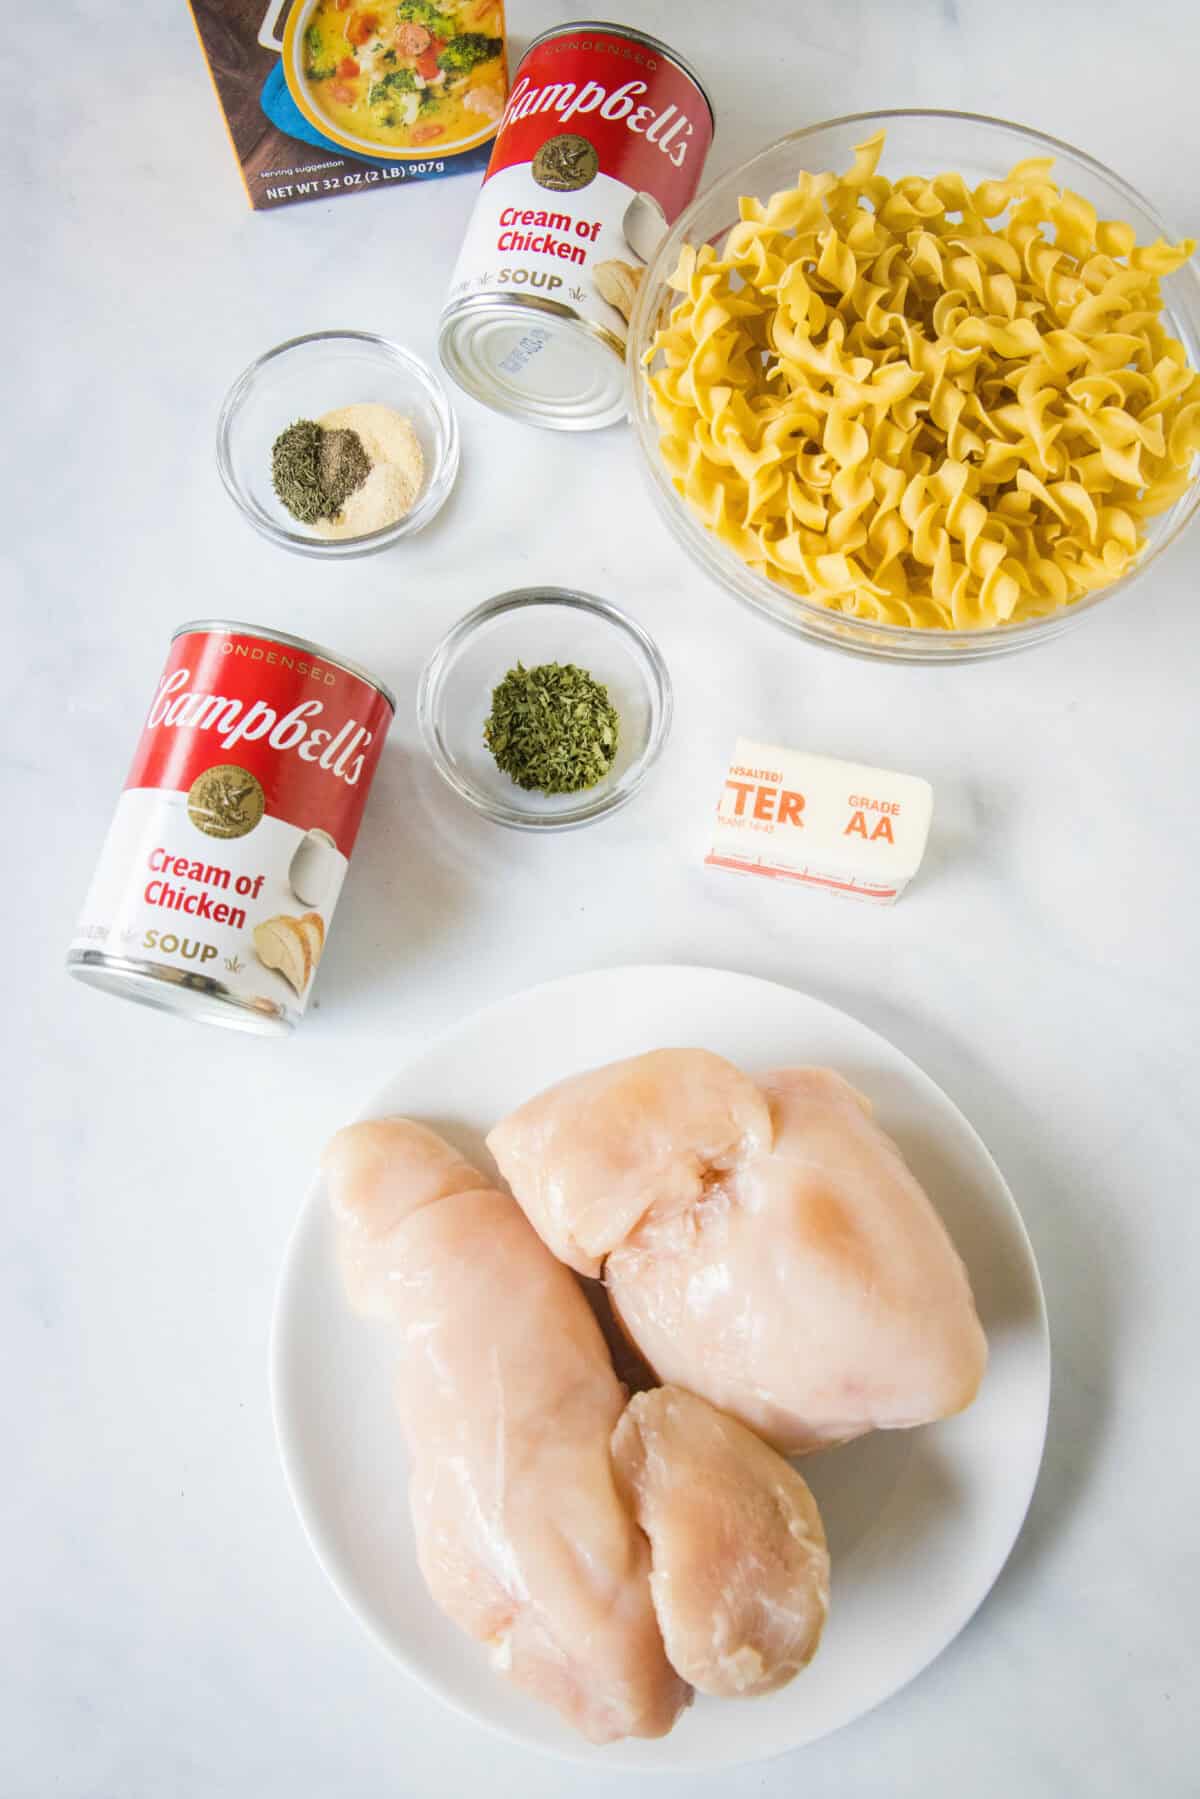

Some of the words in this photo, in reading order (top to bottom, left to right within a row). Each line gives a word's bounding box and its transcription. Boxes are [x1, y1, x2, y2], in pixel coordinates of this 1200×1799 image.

[260, 169, 293, 179] serving
[295, 160, 345, 176] suggestion
[266, 186, 293, 200] NET
[296, 181, 319, 195] WT
[323, 178, 340, 191] 32
[344, 174, 362, 186] OZ
[365, 171, 380, 184] (2
[382, 166, 405, 180] LB)
[408, 161, 445, 176] 907g
[499, 207, 572, 231] Cream
[575, 221, 603, 242] of
[496, 231, 588, 265] Chicken
[497, 268, 563, 291] SOUP
[220, 641, 337, 687] ONDENSED
[146, 668, 373, 785] Campbell's
[716, 779, 807, 829] TER
[848, 794, 903, 816] GRADE
[843, 811, 895, 845] AA
[148, 848, 232, 889] Cream
[235, 875, 265, 900] of
[143, 880, 247, 929] Chicken
[143, 929, 219, 964] SOUP
